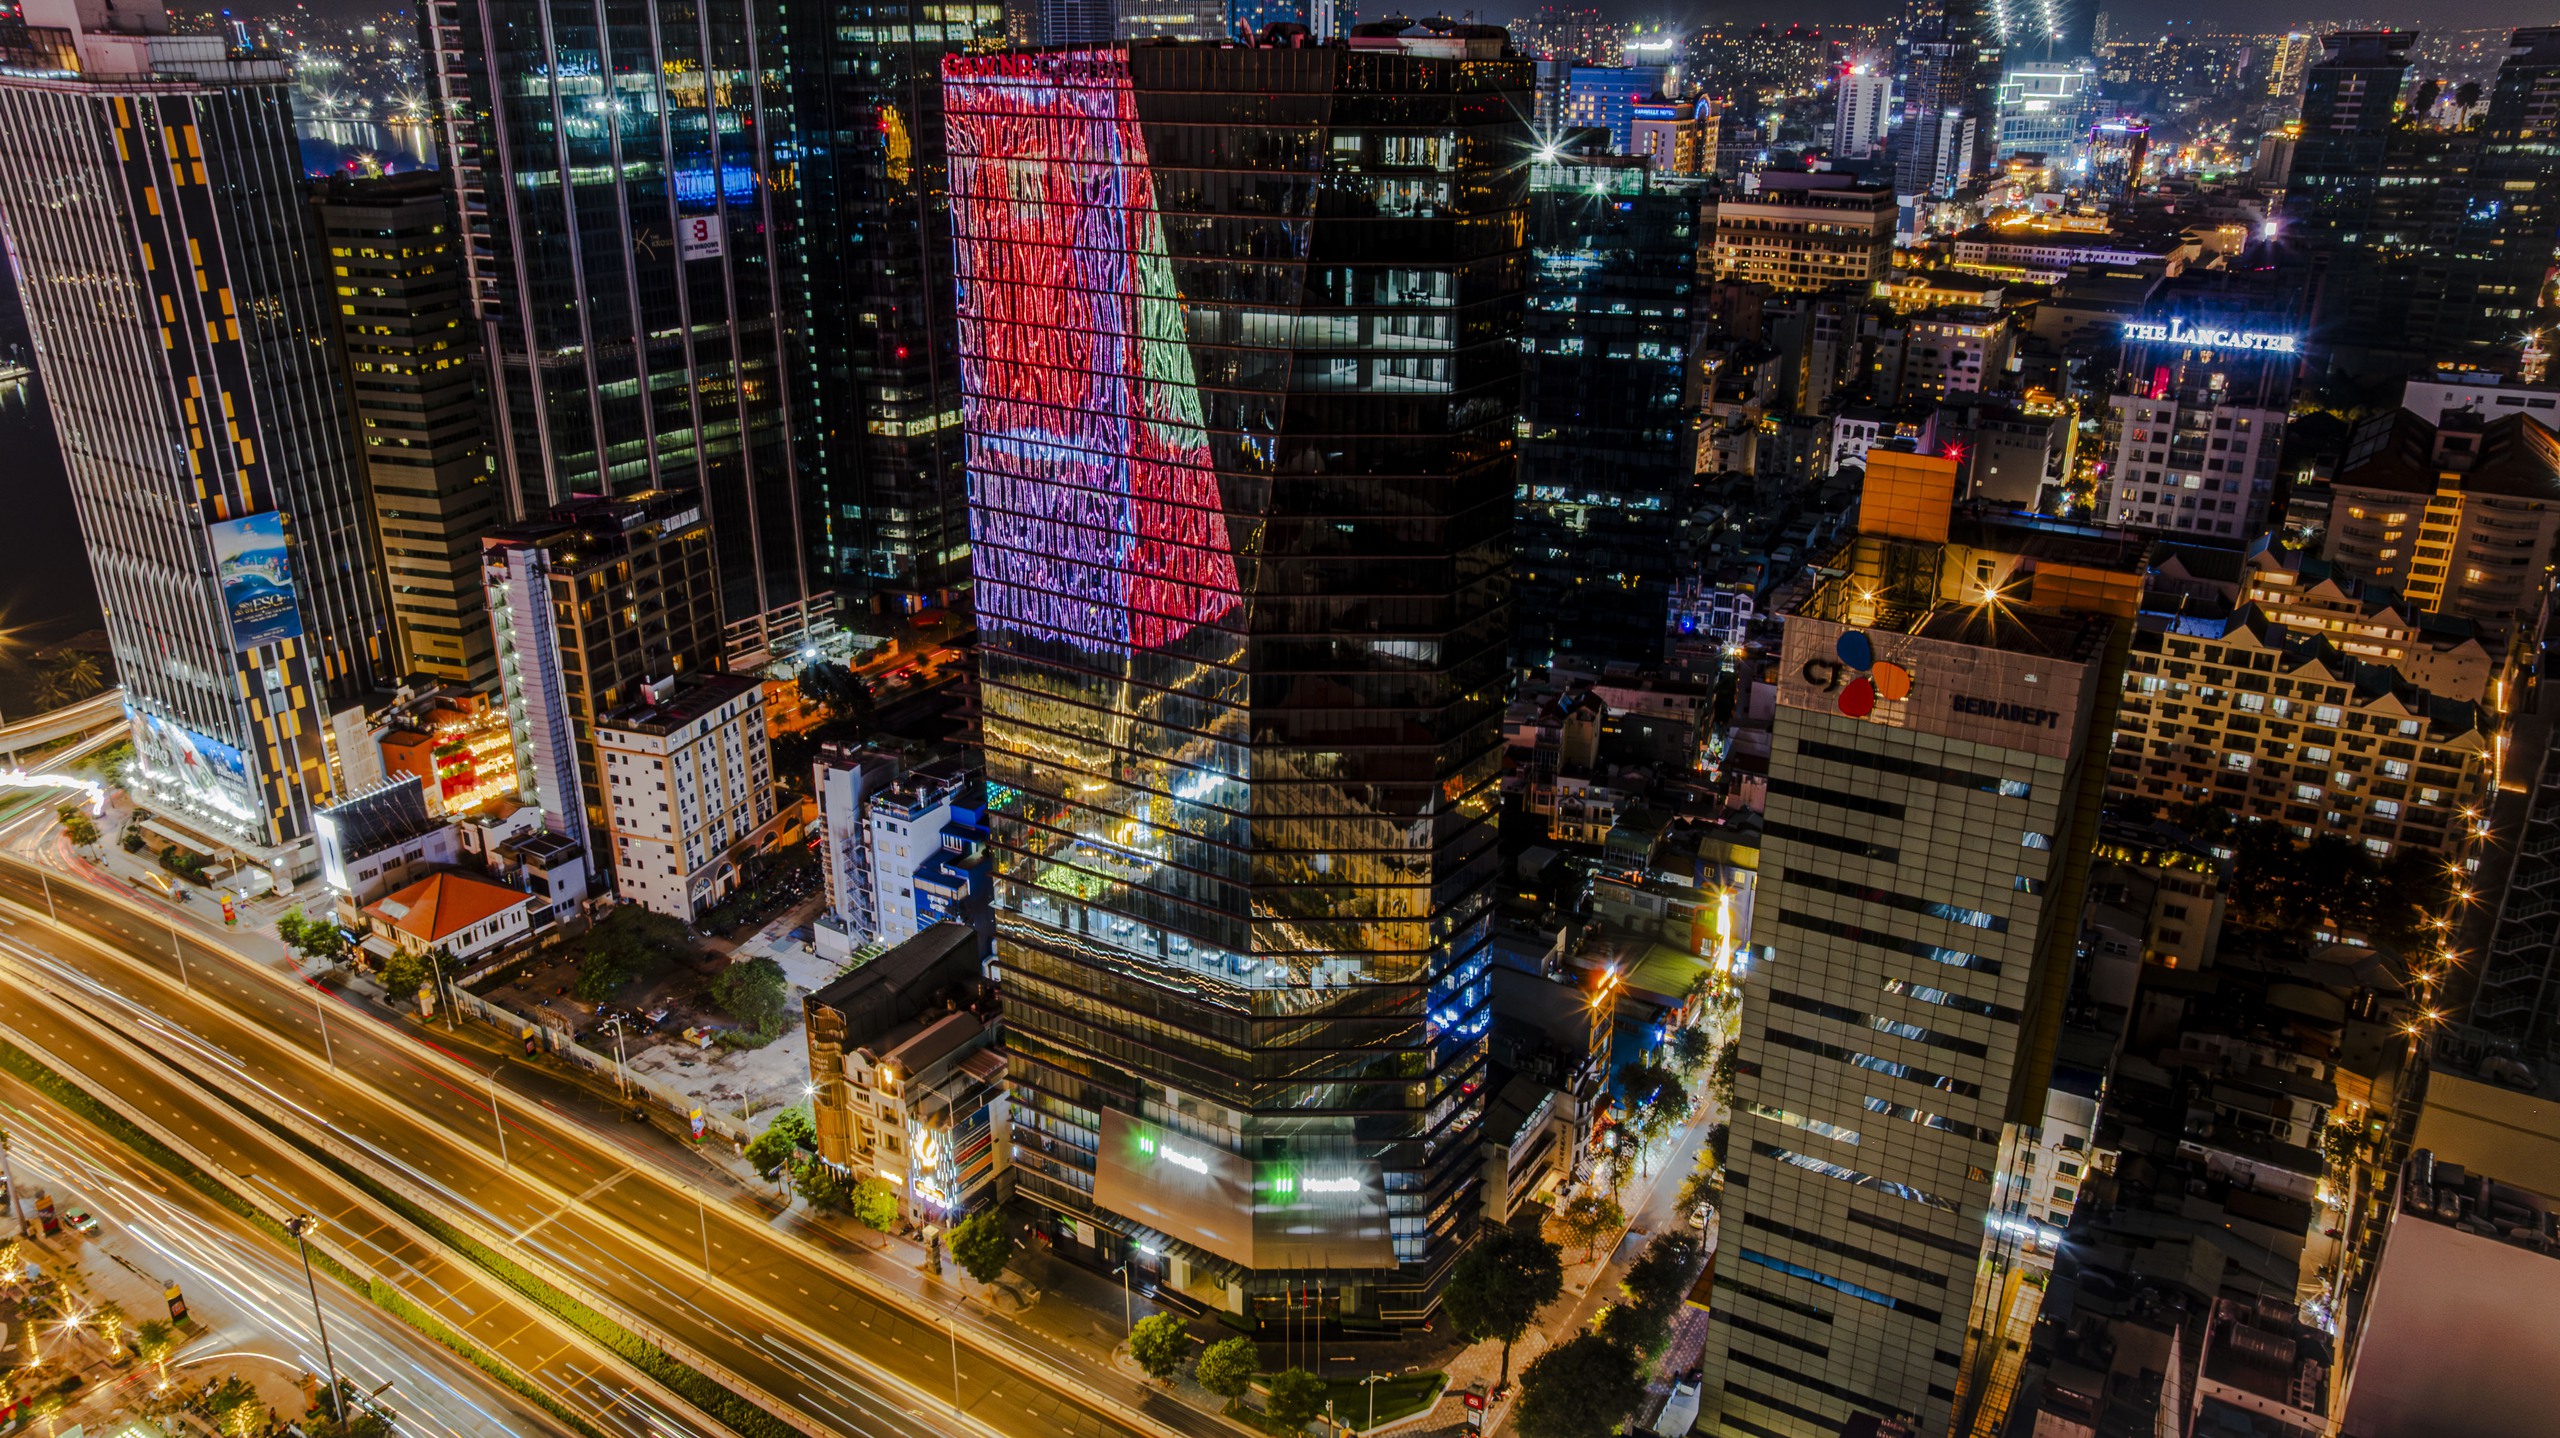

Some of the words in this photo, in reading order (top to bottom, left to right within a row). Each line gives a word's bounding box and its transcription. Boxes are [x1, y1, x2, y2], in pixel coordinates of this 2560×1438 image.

[944, 53, 995, 77] GAW
[1039, 55, 1130, 79] CAPITAL
[2125, 323, 2167, 341] THE
[2169, 319, 2295, 352] LANCASTER
[1802, 658, 1842, 693] CJ
[1952, 694, 2060, 729] GEMADEPT
